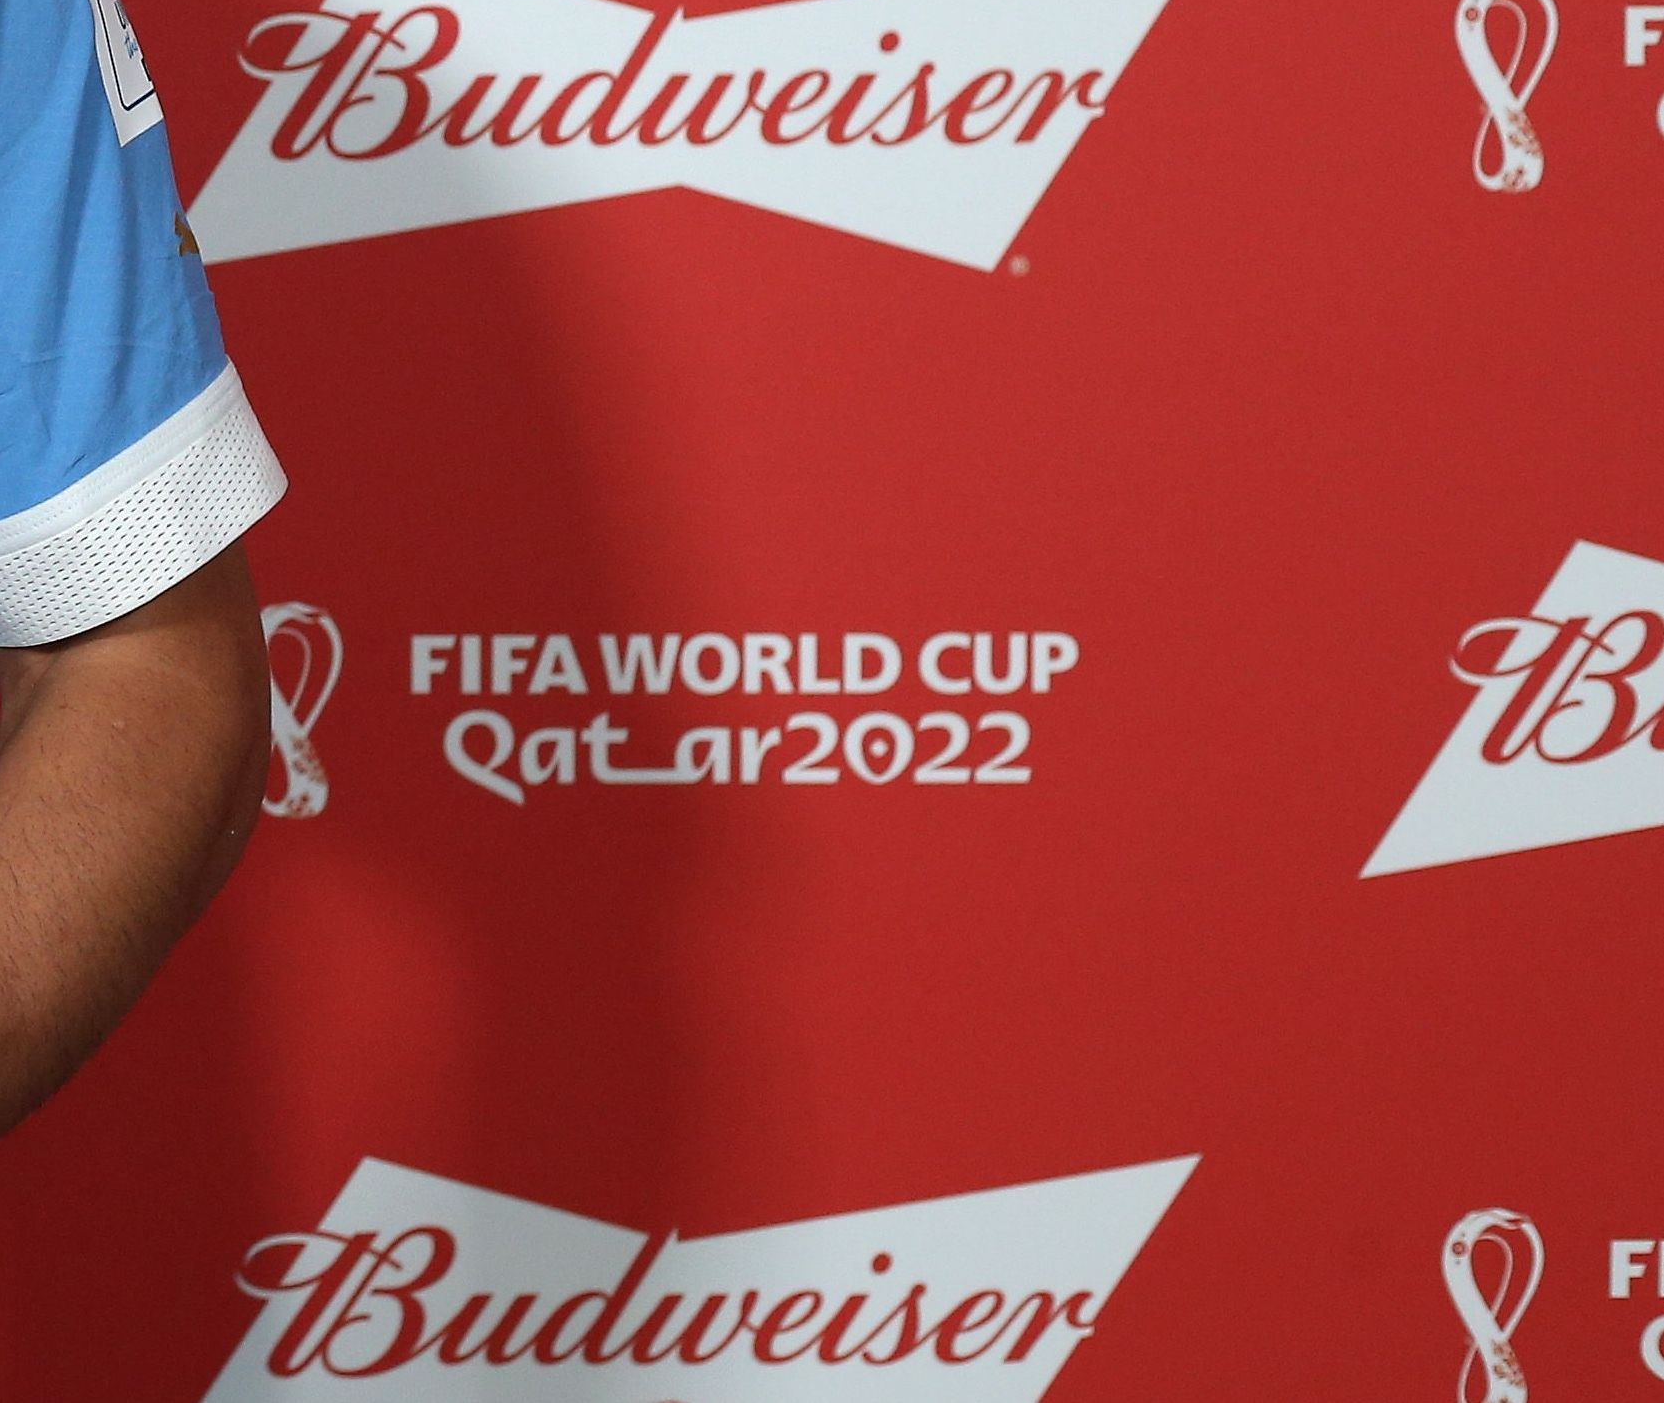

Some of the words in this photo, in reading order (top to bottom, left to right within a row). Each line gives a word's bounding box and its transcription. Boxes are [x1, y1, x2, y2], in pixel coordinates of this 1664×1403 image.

[237, 5, 1105, 162] Budweiser
[411, 633, 587, 695] FIFA
[600, 633, 902, 695] WORLD
[919, 632, 1079, 695] CUP
[443, 710, 1031, 804] Qatar2022
[233, 1225, 1096, 1378] Budweiser
